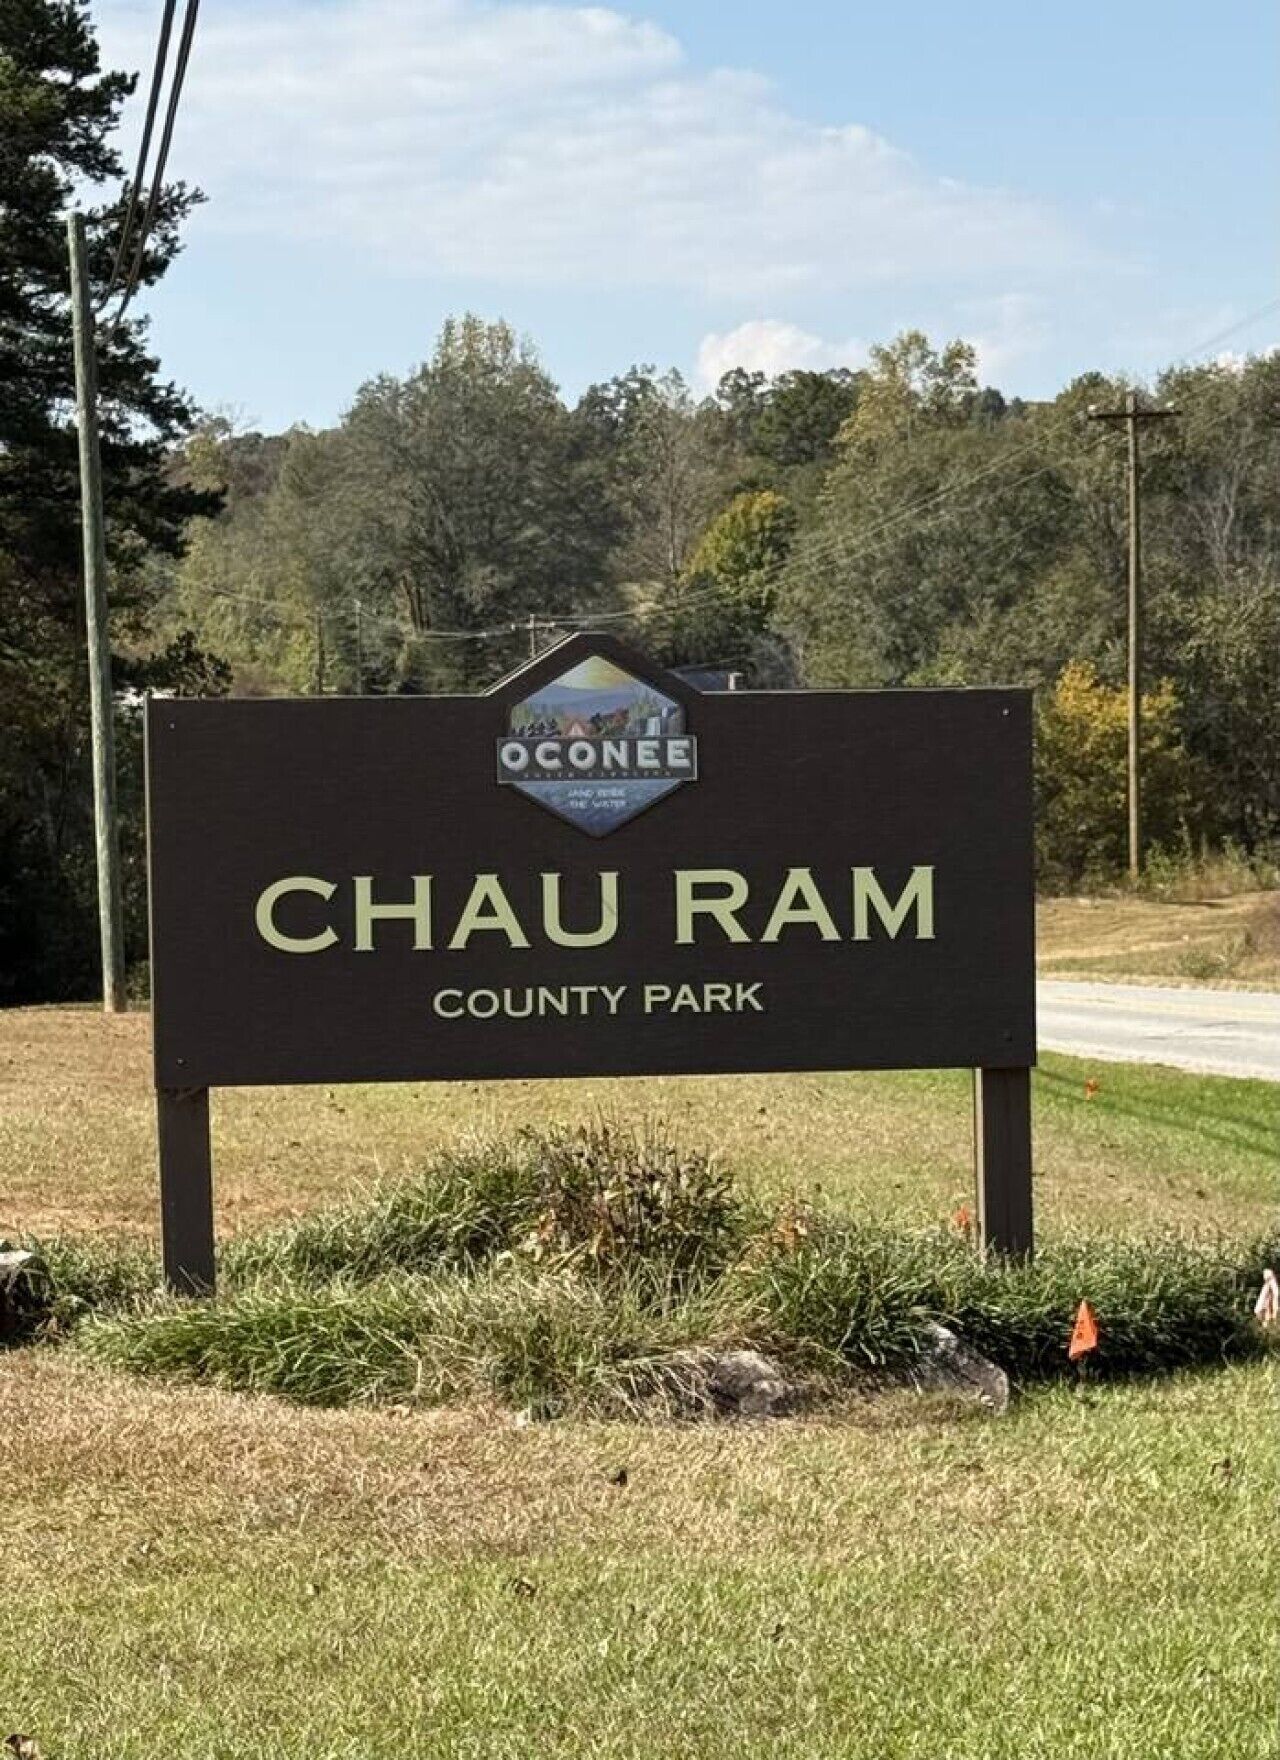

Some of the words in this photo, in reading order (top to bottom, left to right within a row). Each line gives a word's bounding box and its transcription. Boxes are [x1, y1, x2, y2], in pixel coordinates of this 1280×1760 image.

[501, 740, 691, 770] OCONEE
[255, 871, 620, 953] CHAU
[674, 865, 936, 944] RAM
[433, 985, 627, 1018] COUNTY
[644, 982, 764, 1013] PARK
